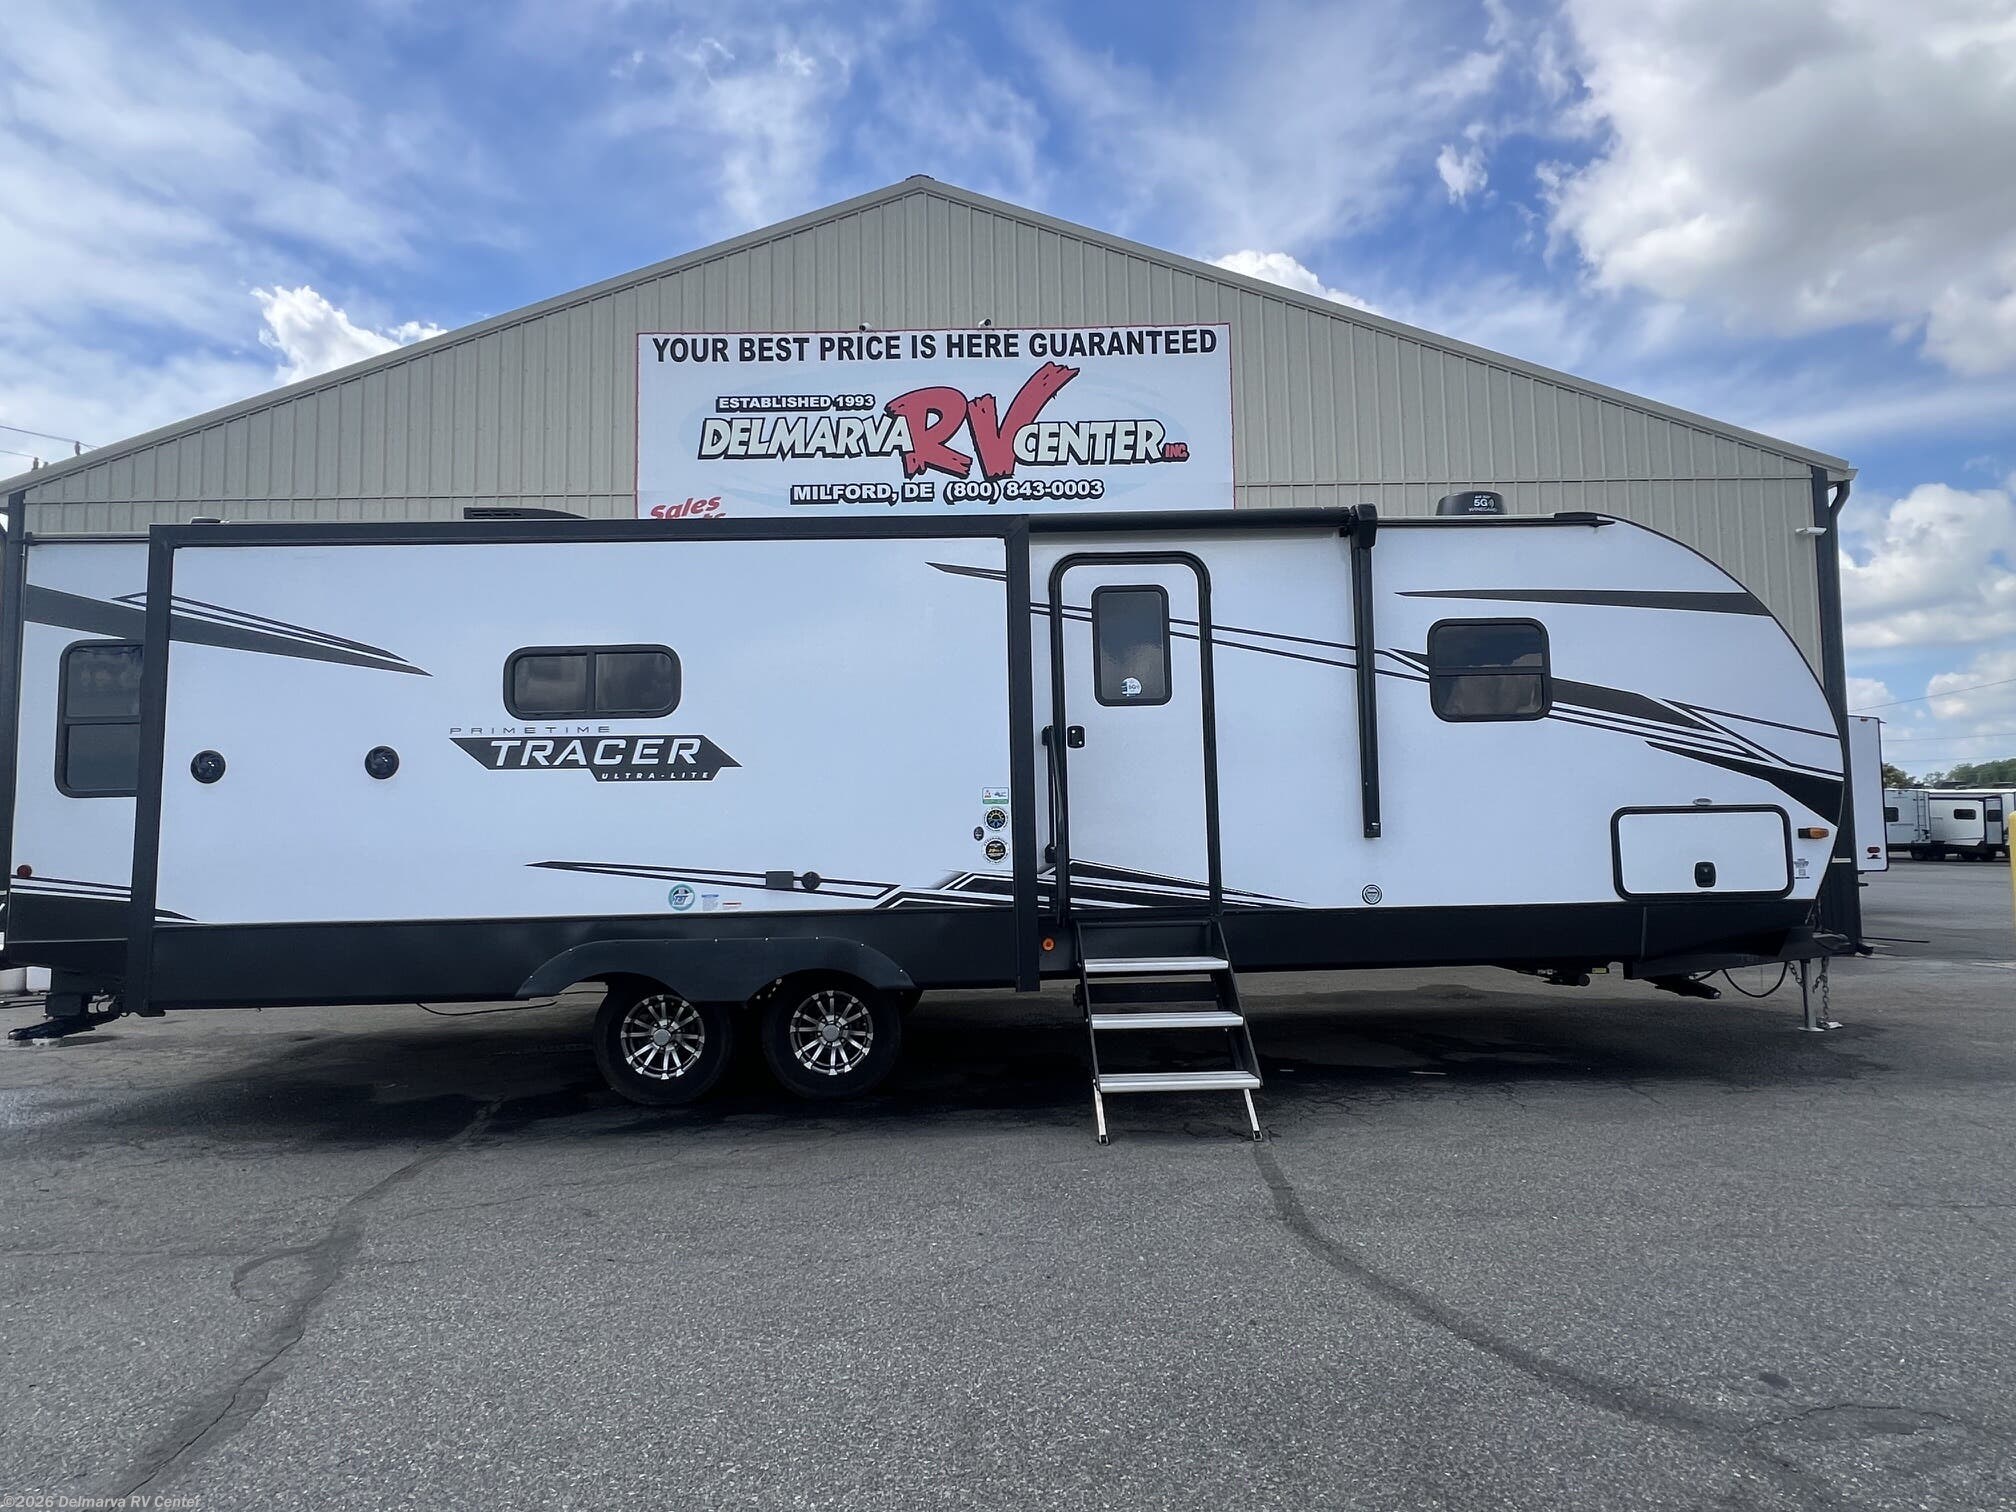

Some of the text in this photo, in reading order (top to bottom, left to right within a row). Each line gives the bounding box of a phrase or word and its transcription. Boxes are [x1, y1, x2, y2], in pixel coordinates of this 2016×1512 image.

[652, 329, 1217, 362] YOUR BEST PRICE IS HERE GUARANTEED
[718, 394, 875, 410] ESTABLISHED 1993
[699, 414, 914, 459] DELMARVA
[884, 361, 1080, 479] RV
[1013, 419, 1165, 465] CENTER
[792, 480, 1104, 504] MILFORD, DE (800) 843-0003
[1473, 499, 1488, 507] 5G
[491, 738, 702, 766] TRACER
[602, 771, 710, 779] ULTRA-LITE
